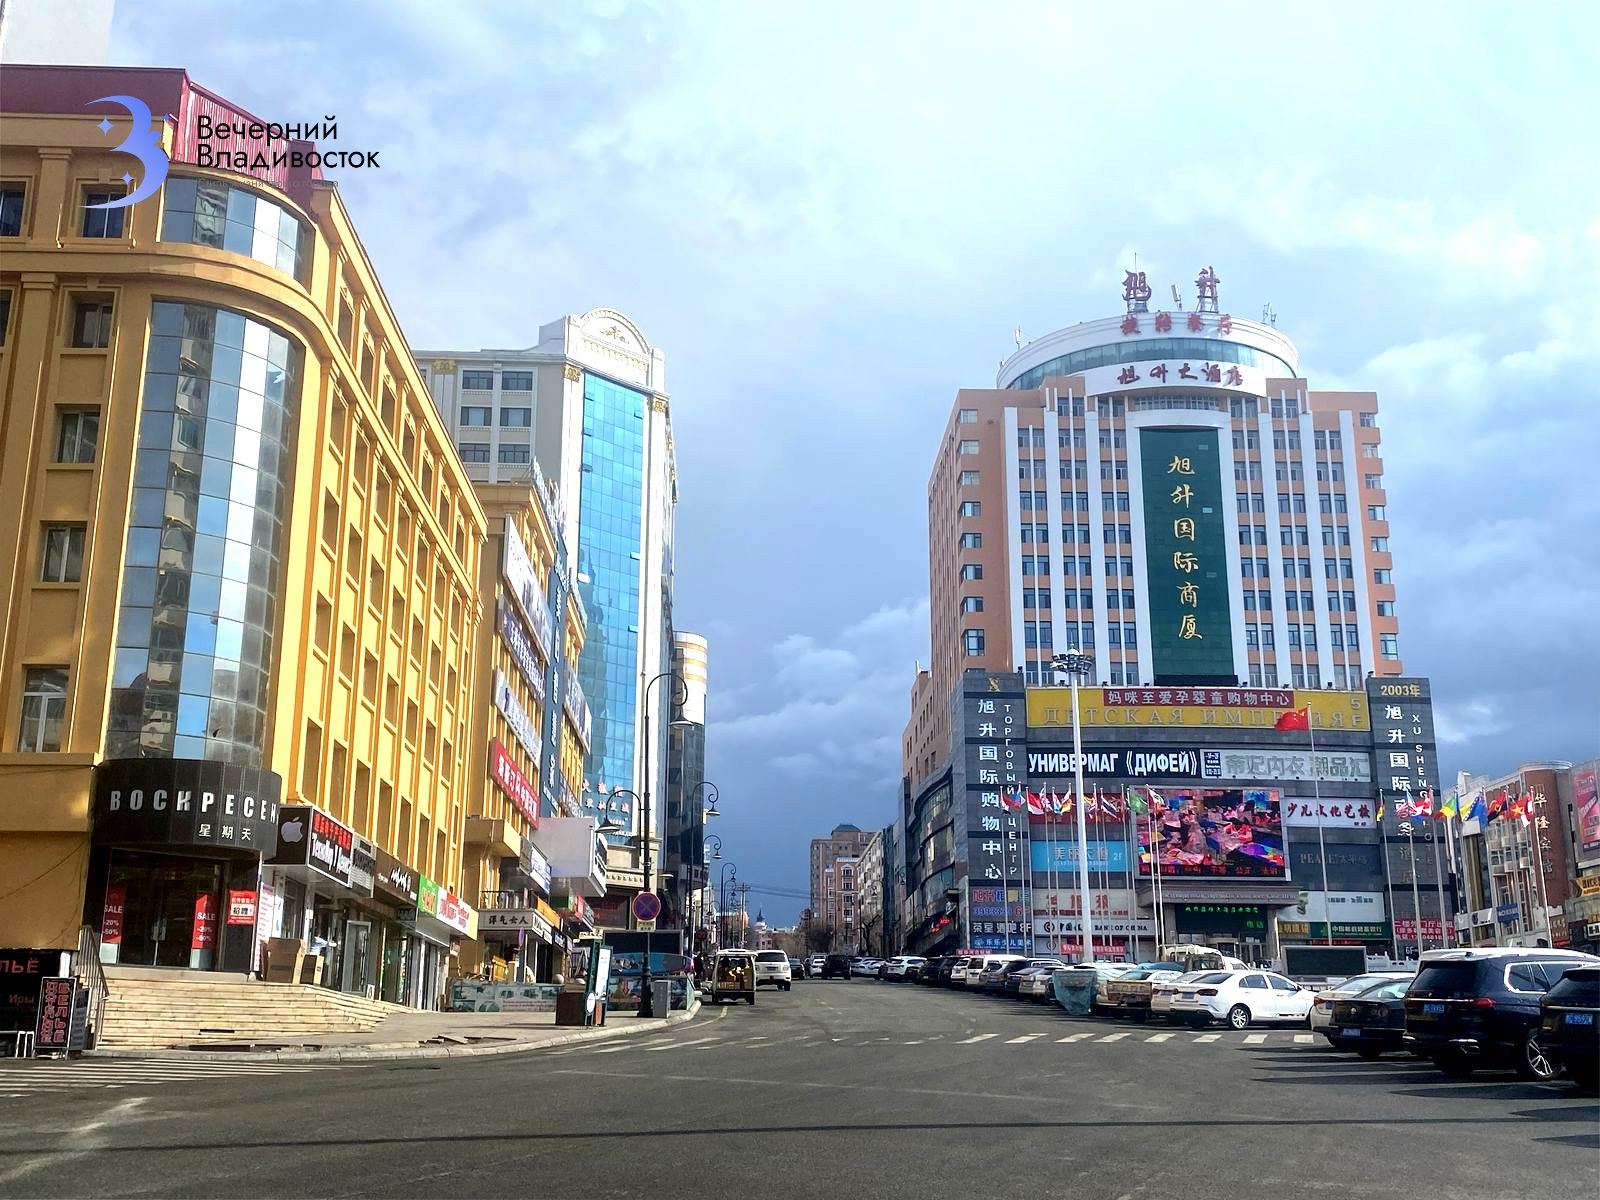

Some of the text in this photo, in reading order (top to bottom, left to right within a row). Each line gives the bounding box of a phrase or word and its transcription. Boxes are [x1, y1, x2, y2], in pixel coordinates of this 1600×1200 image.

[1167, 455, 1203, 640] 旭升国际商厦
[1108, 690, 1290, 706] 妈咪至爱孕婴童购物中心
[1380, 684, 1421, 697] 2003年
[1003, 704, 1016, 796] ТОРГОВЫЙ
[977, 698, 1002, 880] 旭升国际购物中心
[109, 788, 279, 825] ВОСКРЕСЕН
[198, 823, 252, 841] 星期天
[196, 912, 216, 920] SALE
